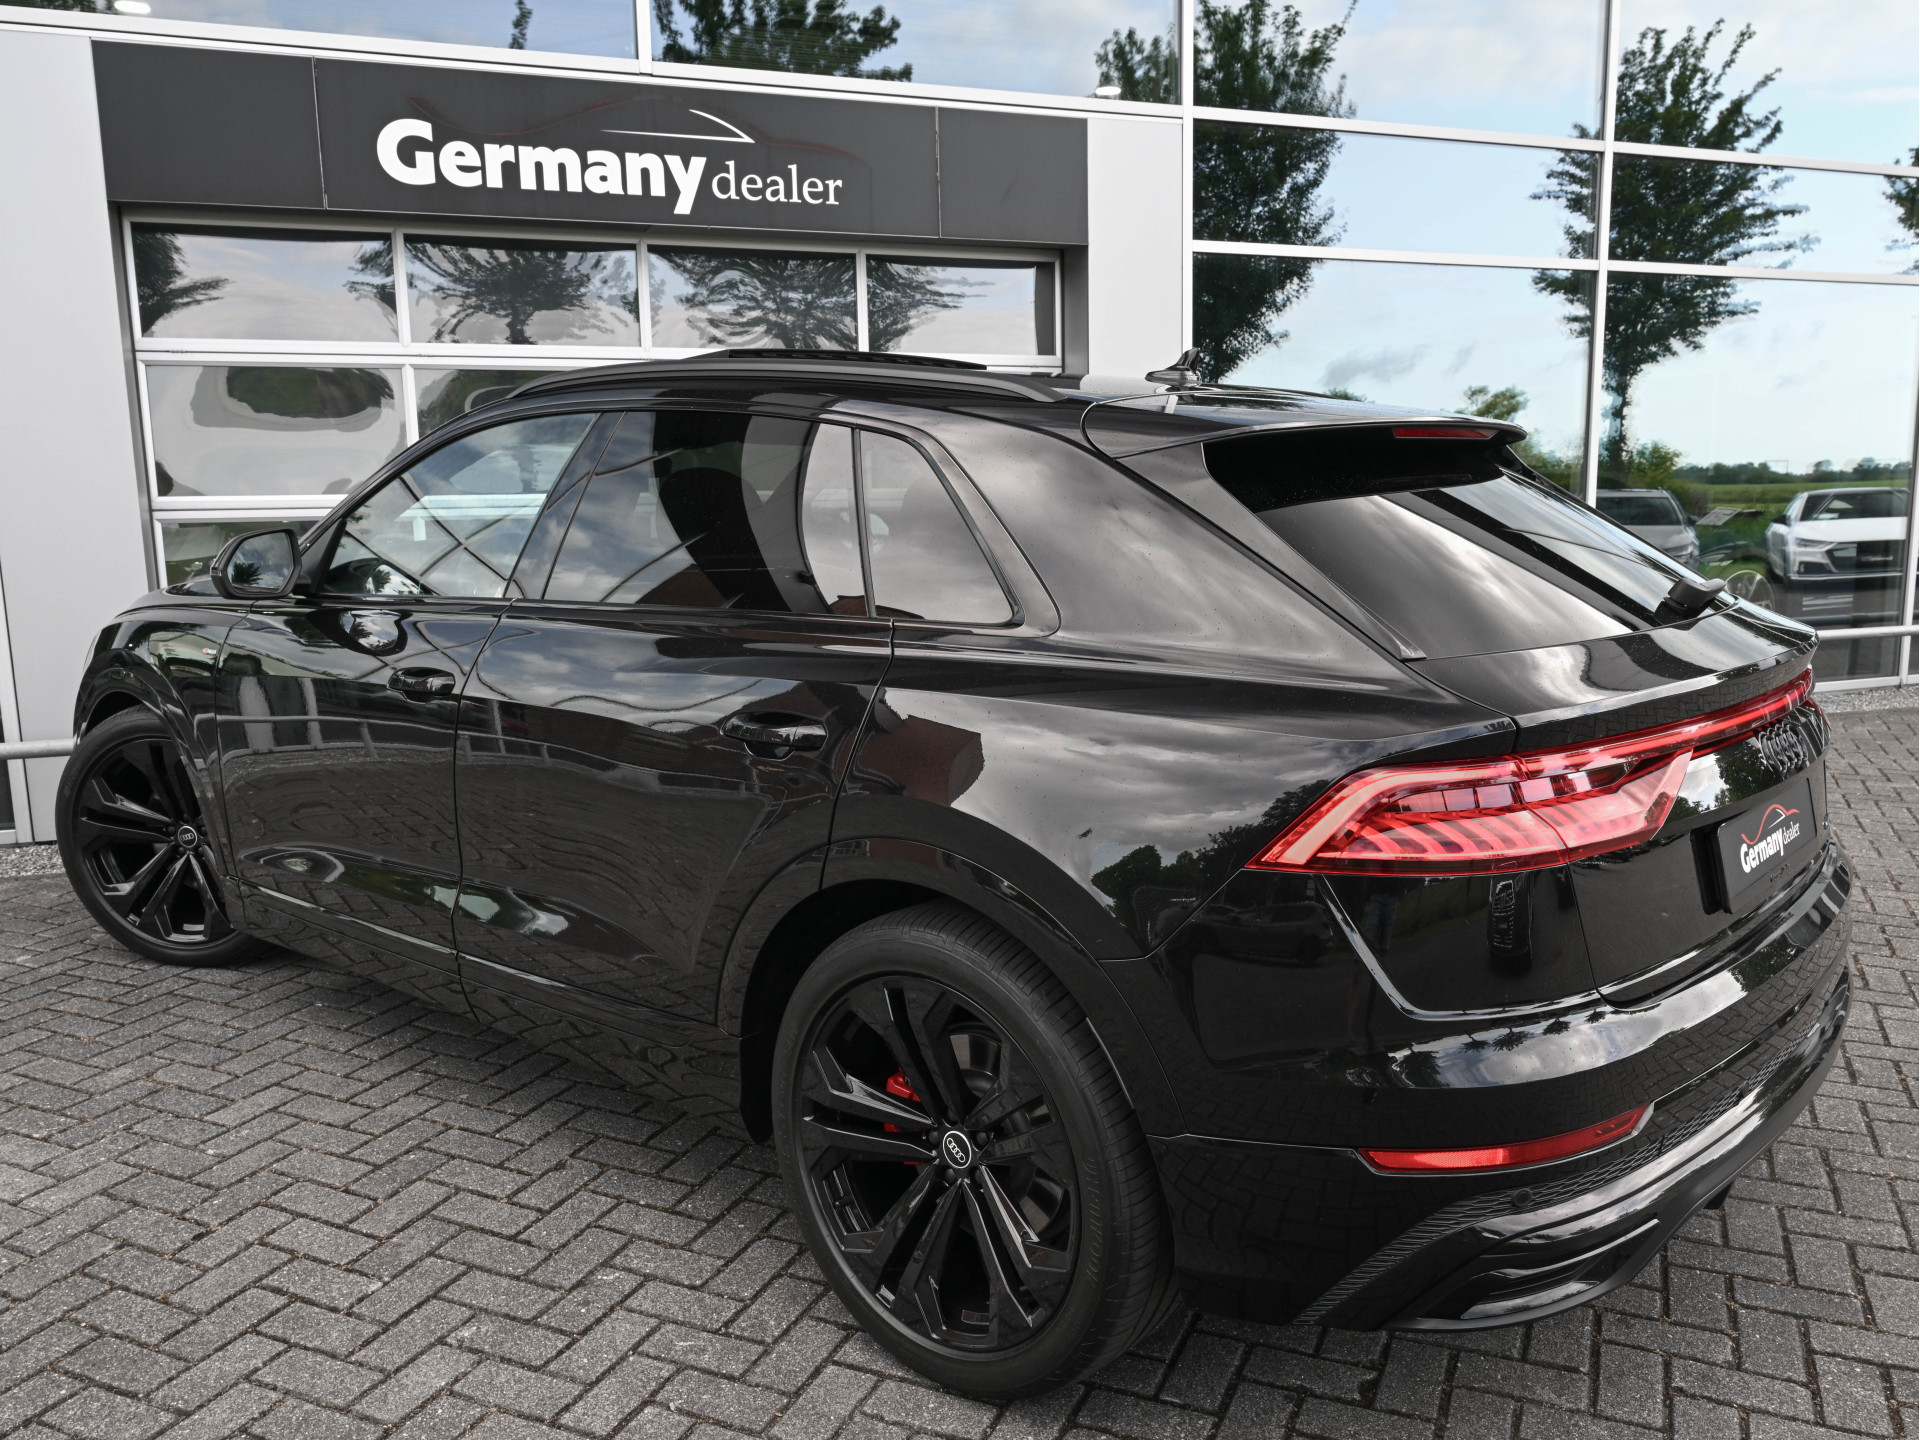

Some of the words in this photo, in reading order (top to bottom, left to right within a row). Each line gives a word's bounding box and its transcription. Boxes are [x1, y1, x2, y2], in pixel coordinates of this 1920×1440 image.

[376, 118, 707, 215] Germany
[711, 160, 843, 205] dealer
[1740, 828, 1784, 874] Germany
[1783, 821, 1800, 845] dealer
